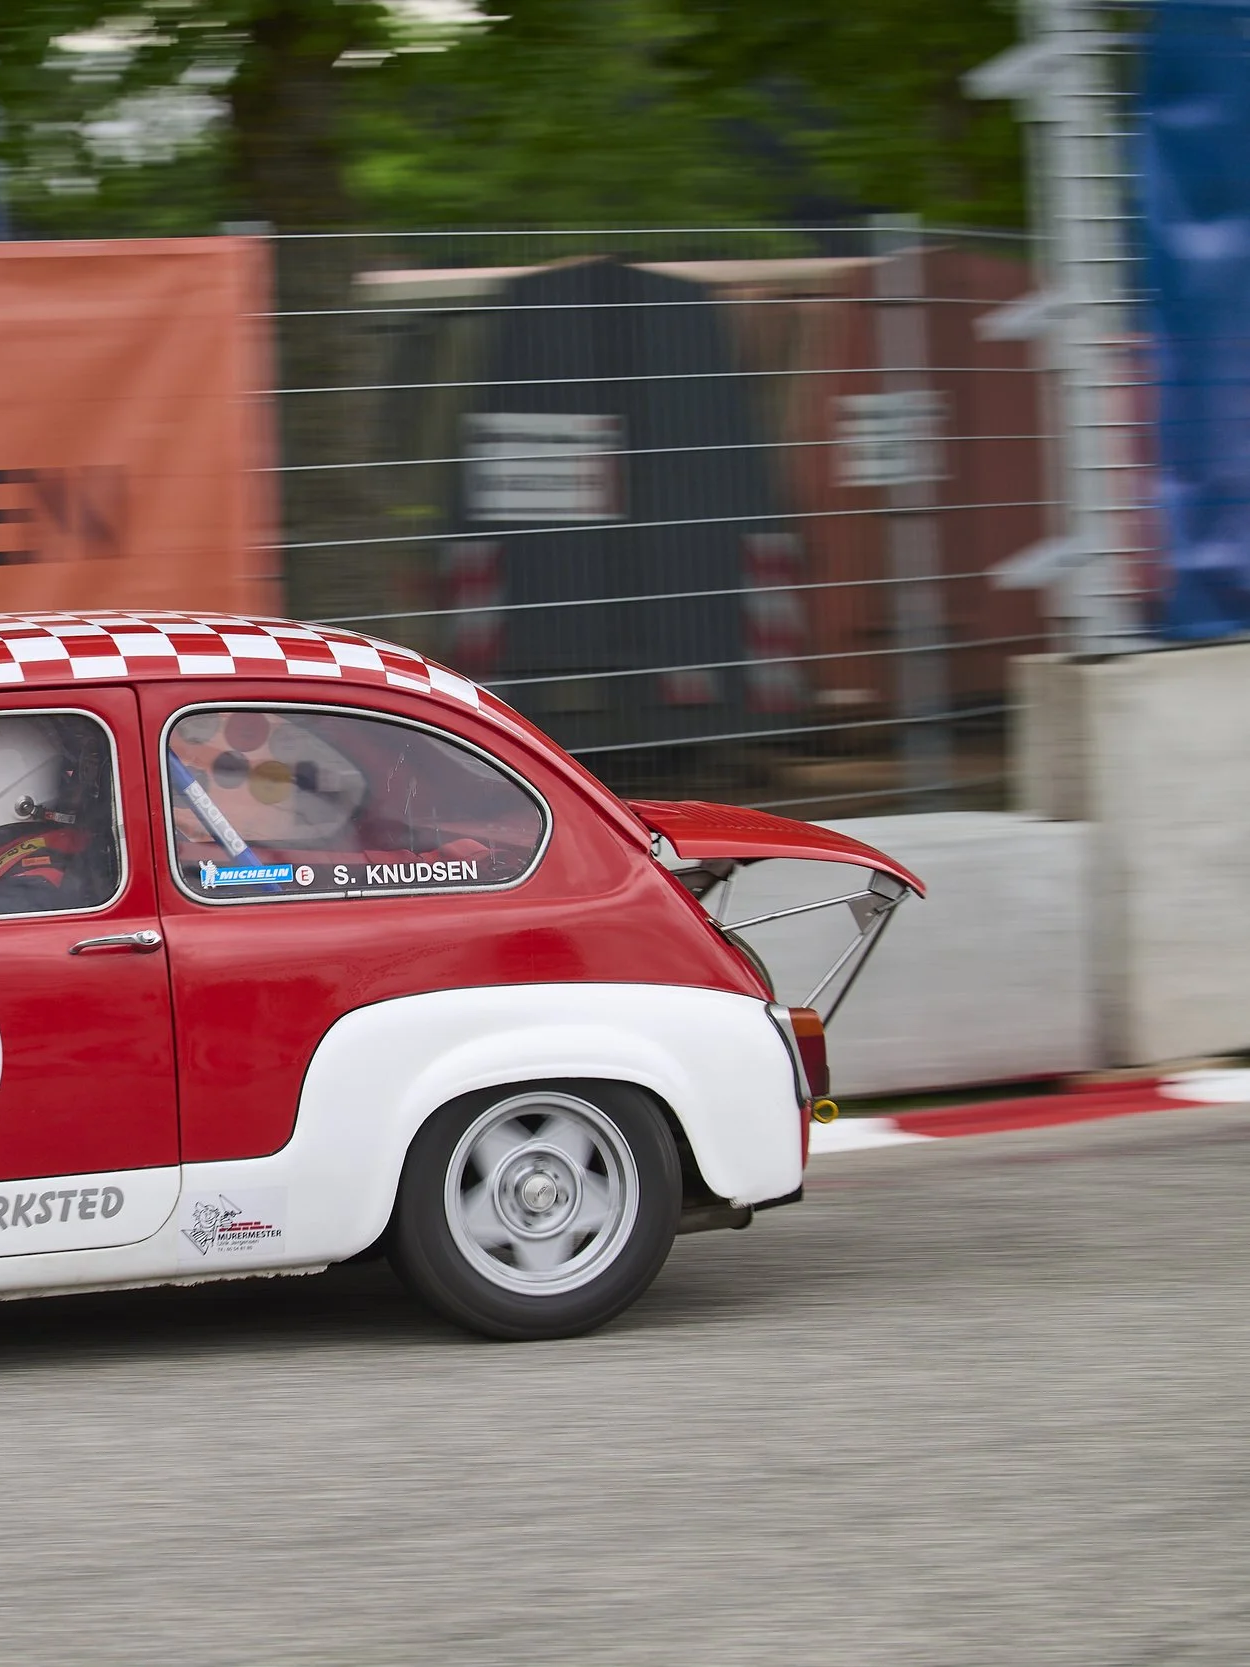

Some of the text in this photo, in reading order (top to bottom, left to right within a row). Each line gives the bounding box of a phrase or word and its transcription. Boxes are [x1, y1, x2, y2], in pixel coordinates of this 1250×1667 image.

[219, 866, 290, 882] MICHELIN
[333, 866, 356, 885] S.
[366, 860, 478, 885] KNUDSEN
[217, 1229, 282, 1241] MURERMESTER
